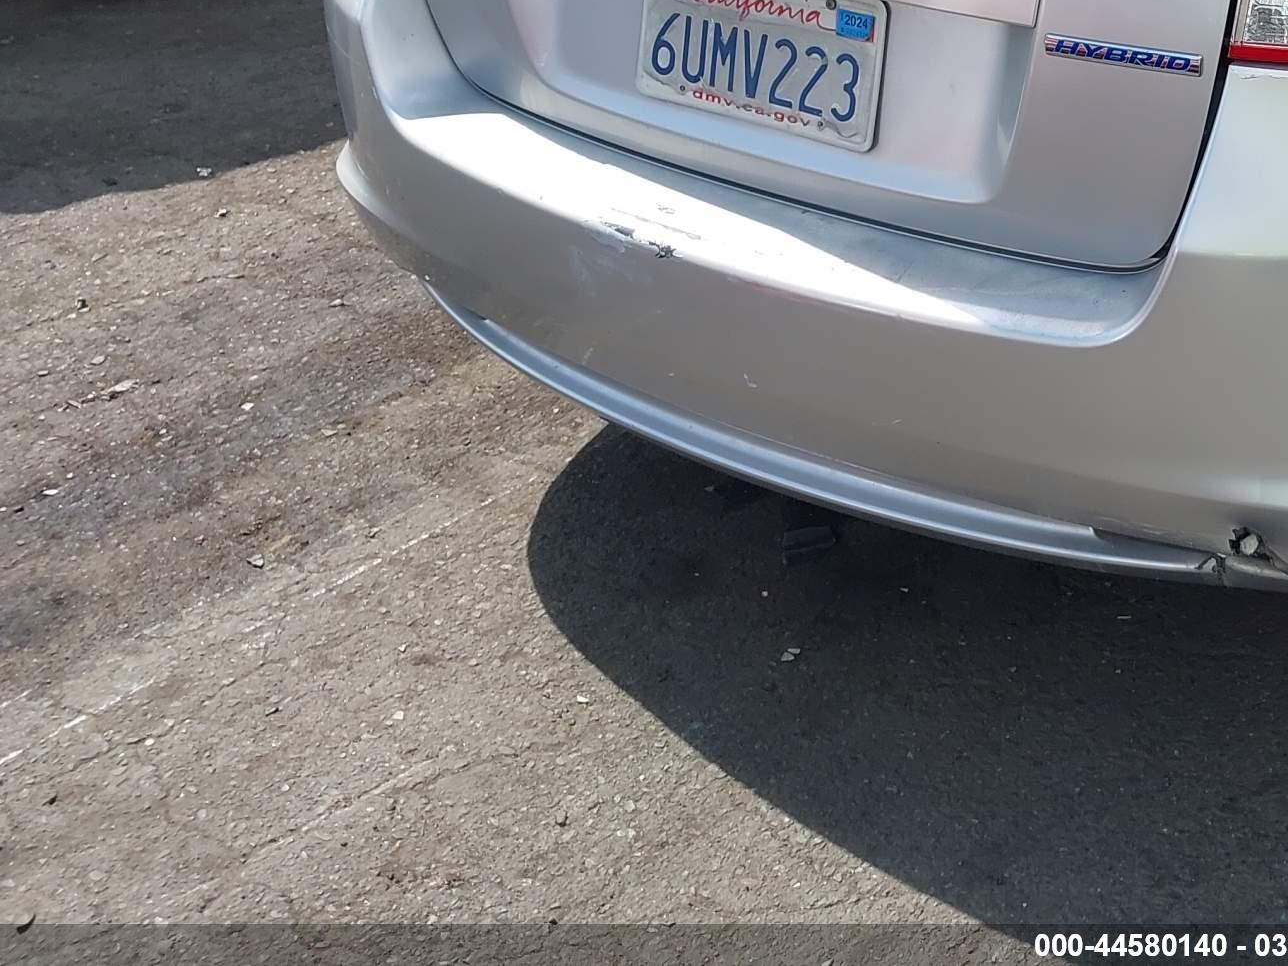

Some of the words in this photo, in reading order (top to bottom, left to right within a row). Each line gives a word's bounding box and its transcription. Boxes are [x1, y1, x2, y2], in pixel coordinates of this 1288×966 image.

[844, 14, 868, 30] 2024
[651, 12, 860, 122] 6UMV223
[1054, 38, 1193, 71] HYBRID
[692, 88, 811, 127] dmv.ca.gov
